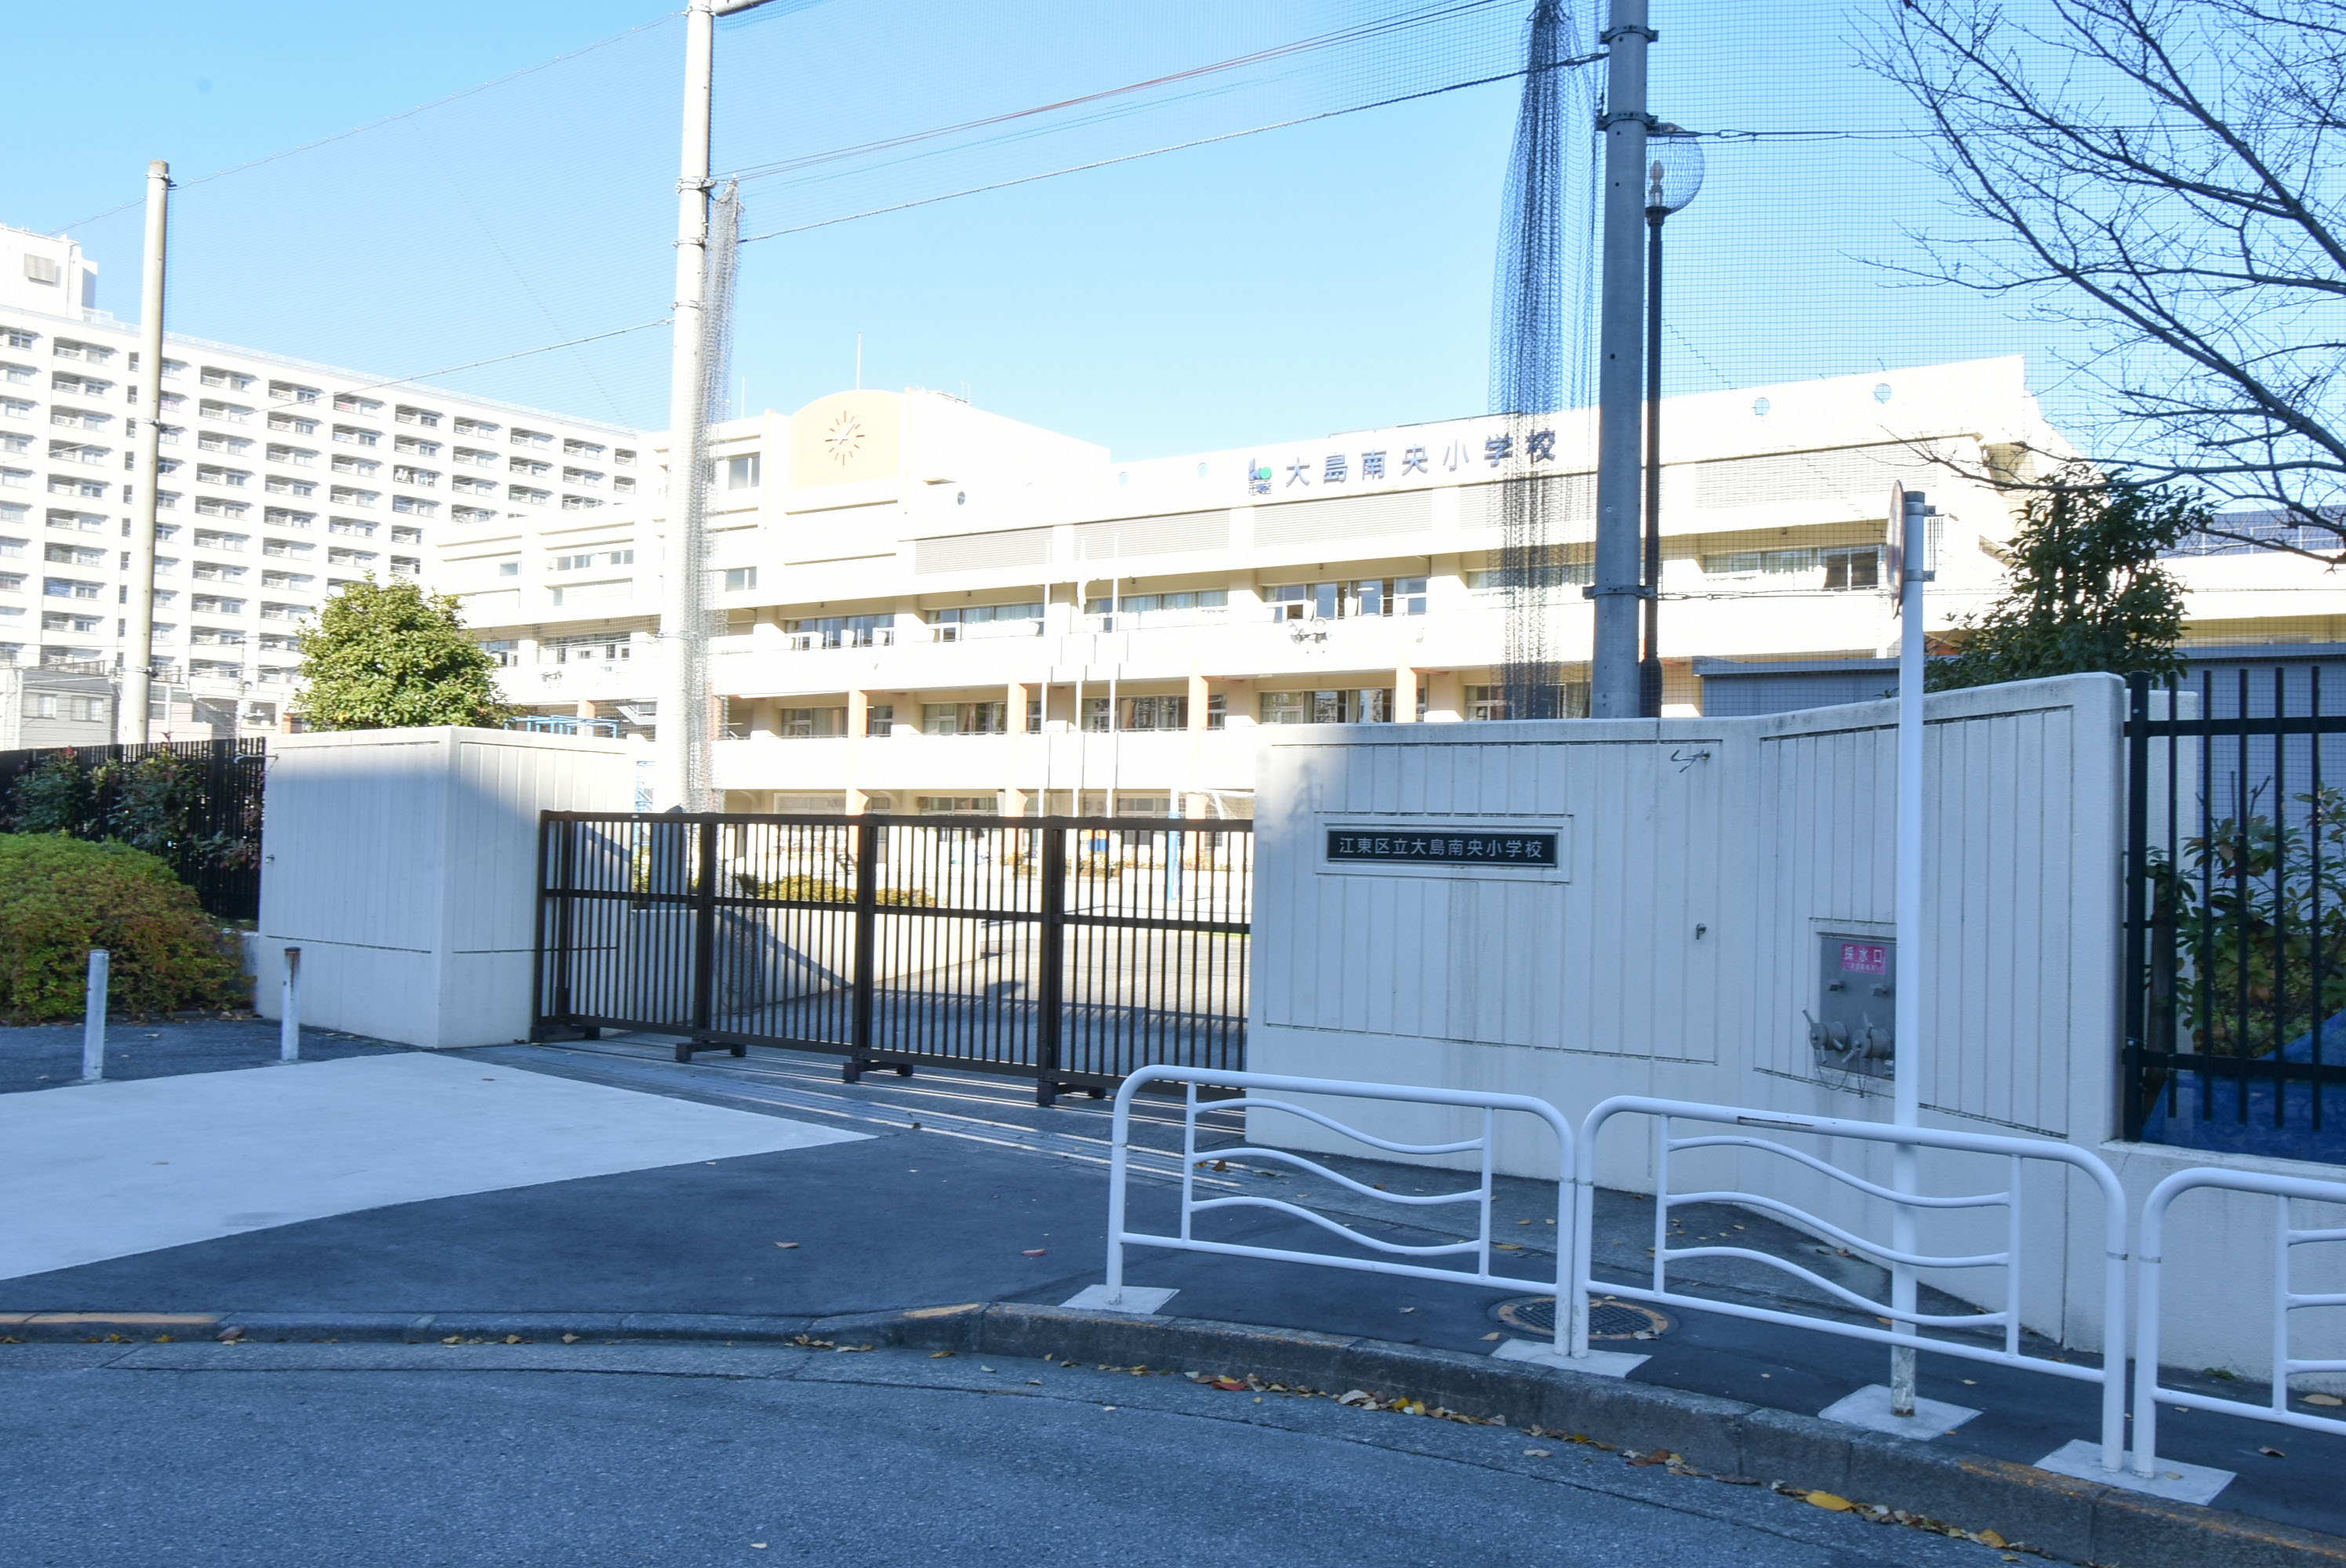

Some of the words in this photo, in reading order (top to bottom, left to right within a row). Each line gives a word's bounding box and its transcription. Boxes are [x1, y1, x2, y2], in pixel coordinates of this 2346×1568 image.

[1285, 428, 1556, 488] 大島南央小学校
[1338, 837, 1542, 858] 江東区立大島南央小学校
